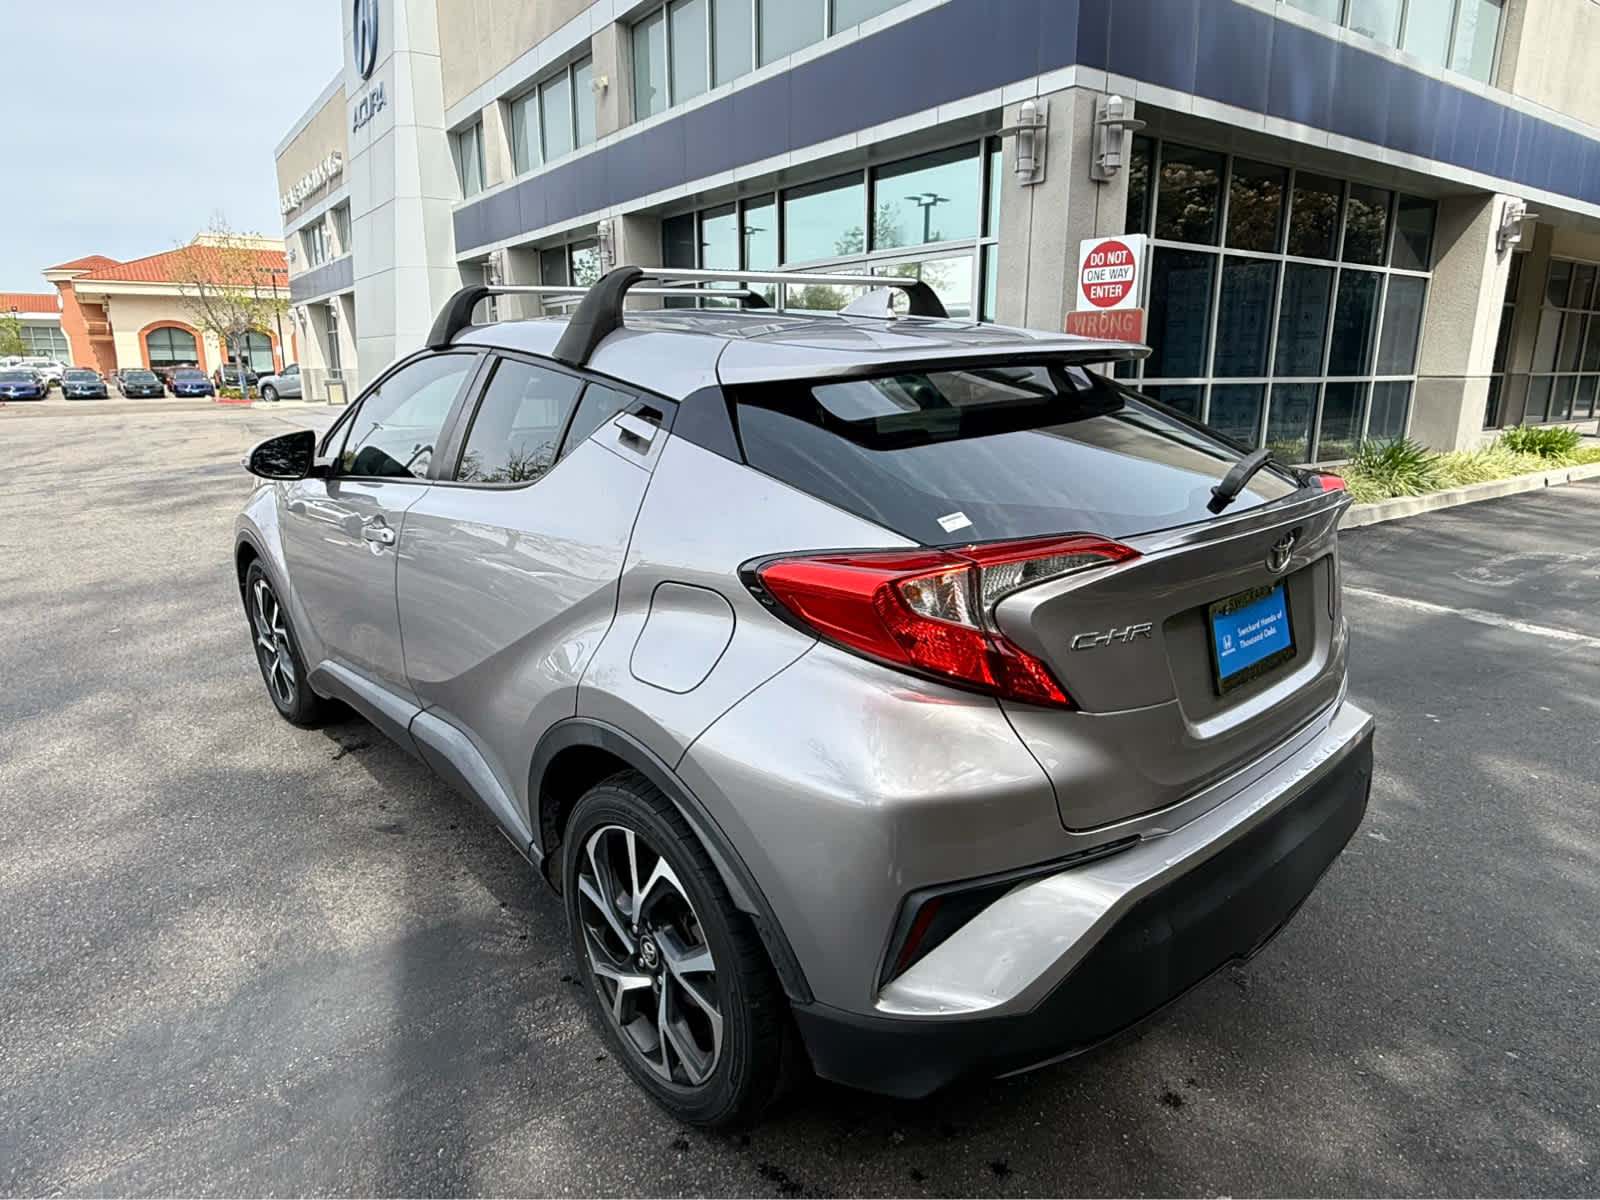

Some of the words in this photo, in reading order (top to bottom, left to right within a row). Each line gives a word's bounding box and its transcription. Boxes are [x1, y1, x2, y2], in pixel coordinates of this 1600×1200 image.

[352, 81, 387, 133] ACURA
[1090, 253, 1104, 266] DO
[1107, 250, 1128, 264] NOT
[1087, 268, 1106, 282] ONE
[1109, 267, 1130, 280] WAY
[1090, 285, 1122, 299] ENTER
[1073, 314, 1134, 334] WRONG
[1260, 614, 1277, 626] Honda
[1277, 610, 1282, 619] of
[1071, 622, 1153, 649] C-HR
[1239, 632, 1263, 649] Thousand
[1263, 626, 1277, 638] Oaks
